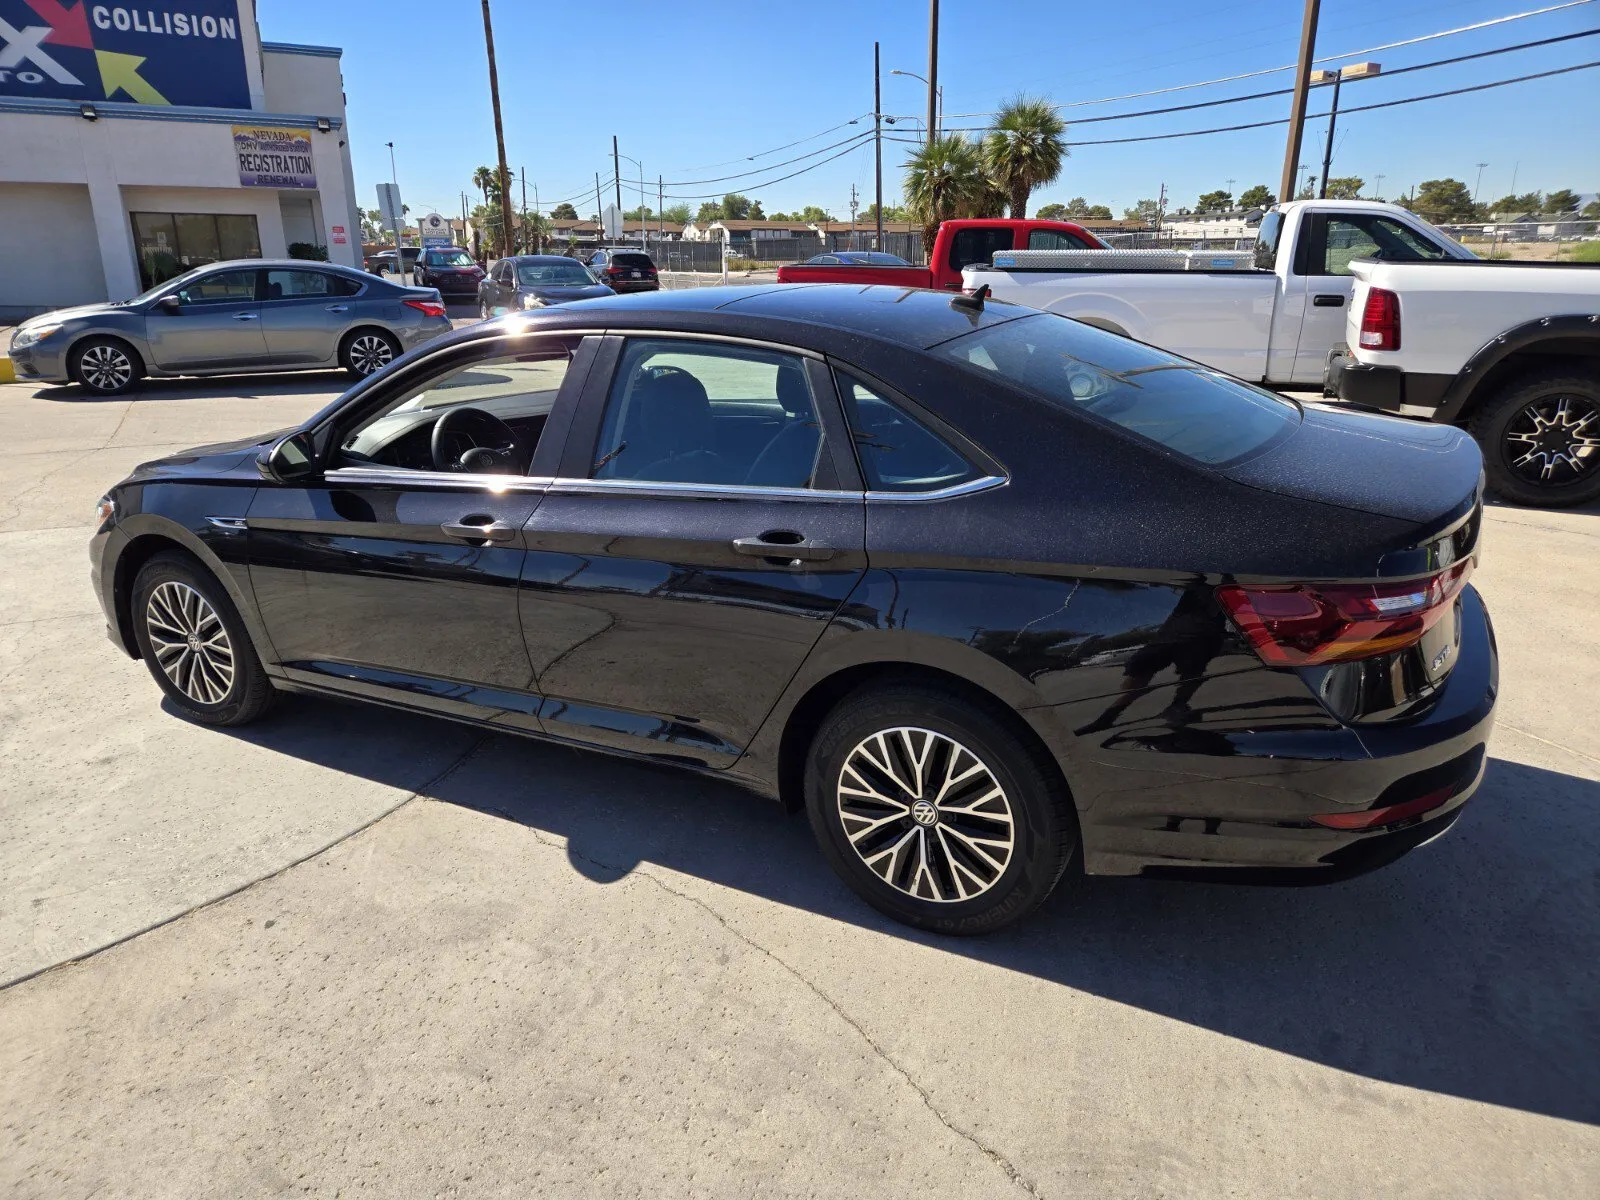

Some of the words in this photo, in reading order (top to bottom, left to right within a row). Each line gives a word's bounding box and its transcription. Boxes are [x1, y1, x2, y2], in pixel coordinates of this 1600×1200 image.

[92, 5, 237, 40] COLLISION
[252, 130, 292, 142] NEVADA
[241, 141, 258, 151] DMV
[239, 153, 312, 174] REGISTRATION
[257, 174, 299, 185] RENEWAL
